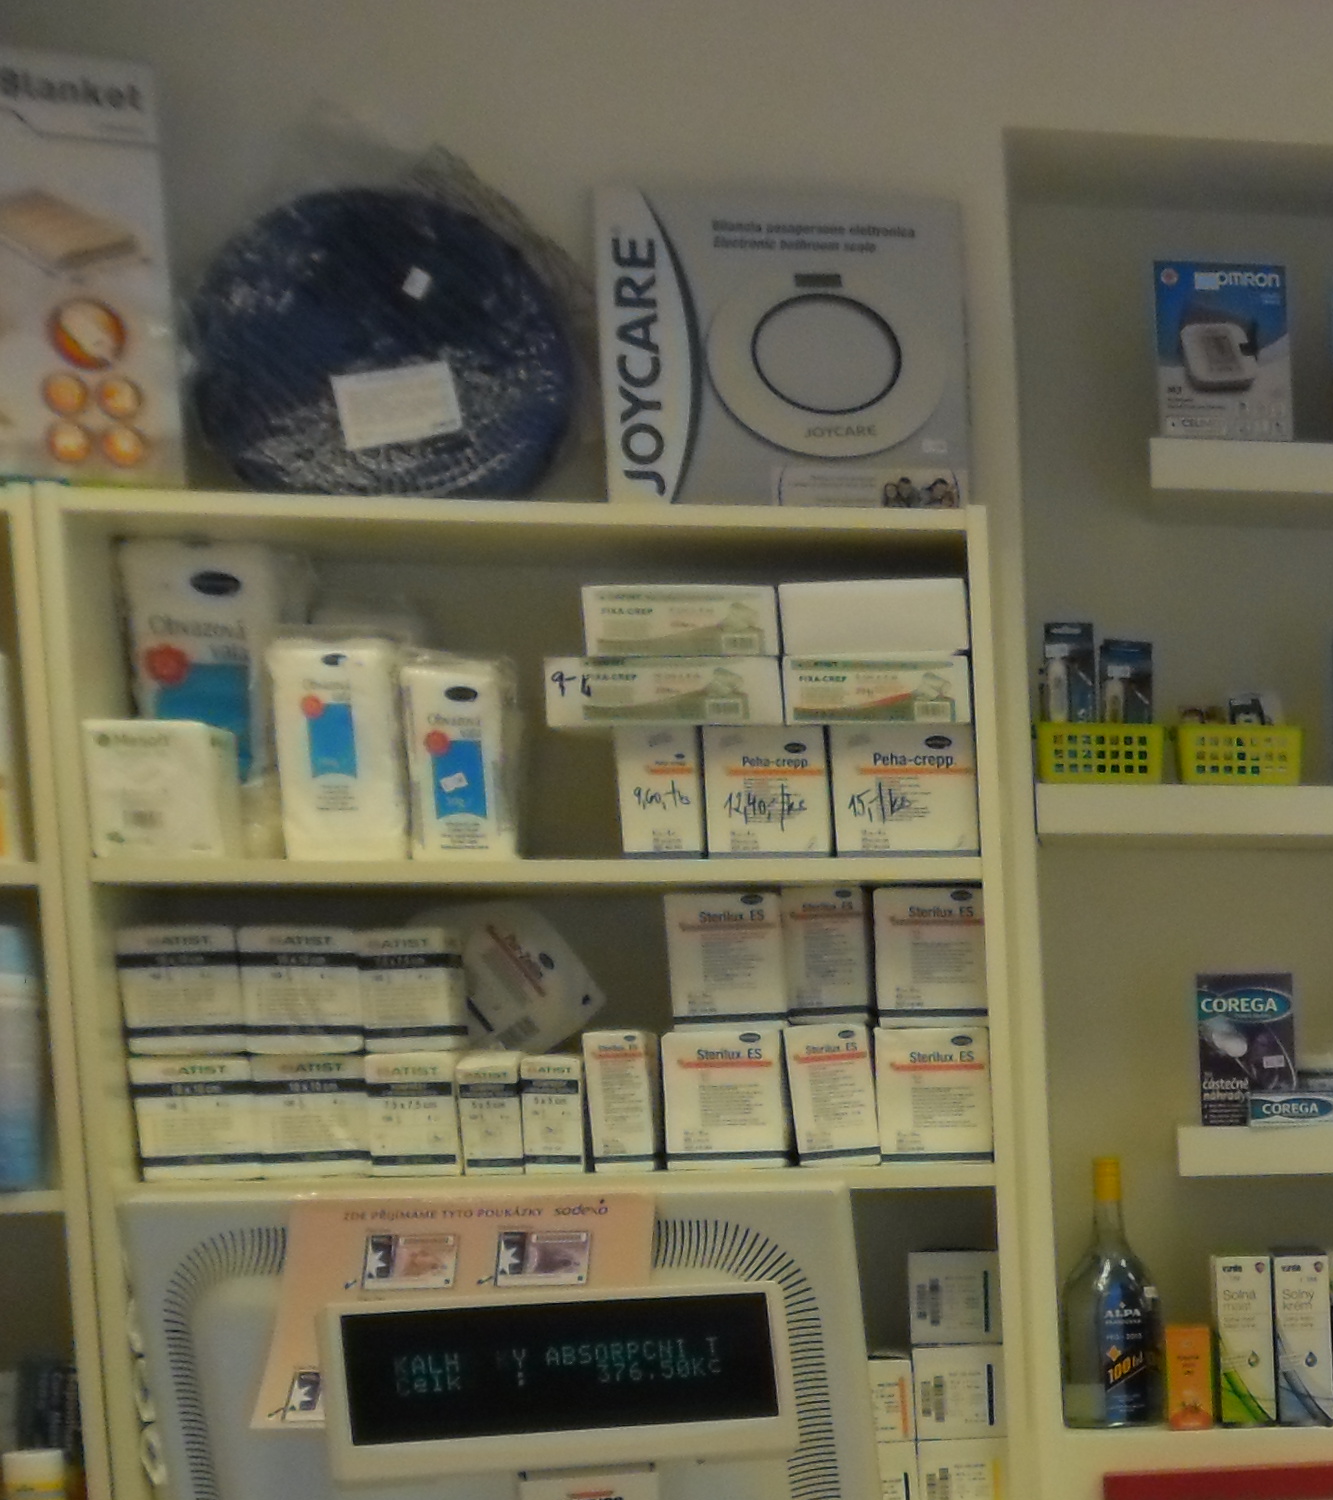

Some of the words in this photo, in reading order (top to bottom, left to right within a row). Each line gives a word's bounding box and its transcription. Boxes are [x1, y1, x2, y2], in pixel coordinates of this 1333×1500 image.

[611, 238, 666, 496] JOYCARE
[804, 424, 877, 438] JOYCARE
[741, 755, 809, 770] Peha-crepp
[872, 751, 955, 768] Peha-crepp
[699, 910, 743, 924] Sterilux
[749, 909, 766, 921] ES
[908, 906, 952, 920] Sterilux
[957, 905, 975, 919] ES
[1200, 996, 1278, 1013] COREGA
[696, 1047, 741, 1061] Sterilux
[746, 1047, 763, 1060] ES
[909, 1050, 953, 1064] Sterilux
[959, 1050, 975, 1062] ES
[1261, 1102, 1319, 1116] COREGA
[441, 1209, 474, 1219] TYTO
[1104, 1308, 1142, 1319] ALPA
[1107, 1355, 1131, 1384] 100
